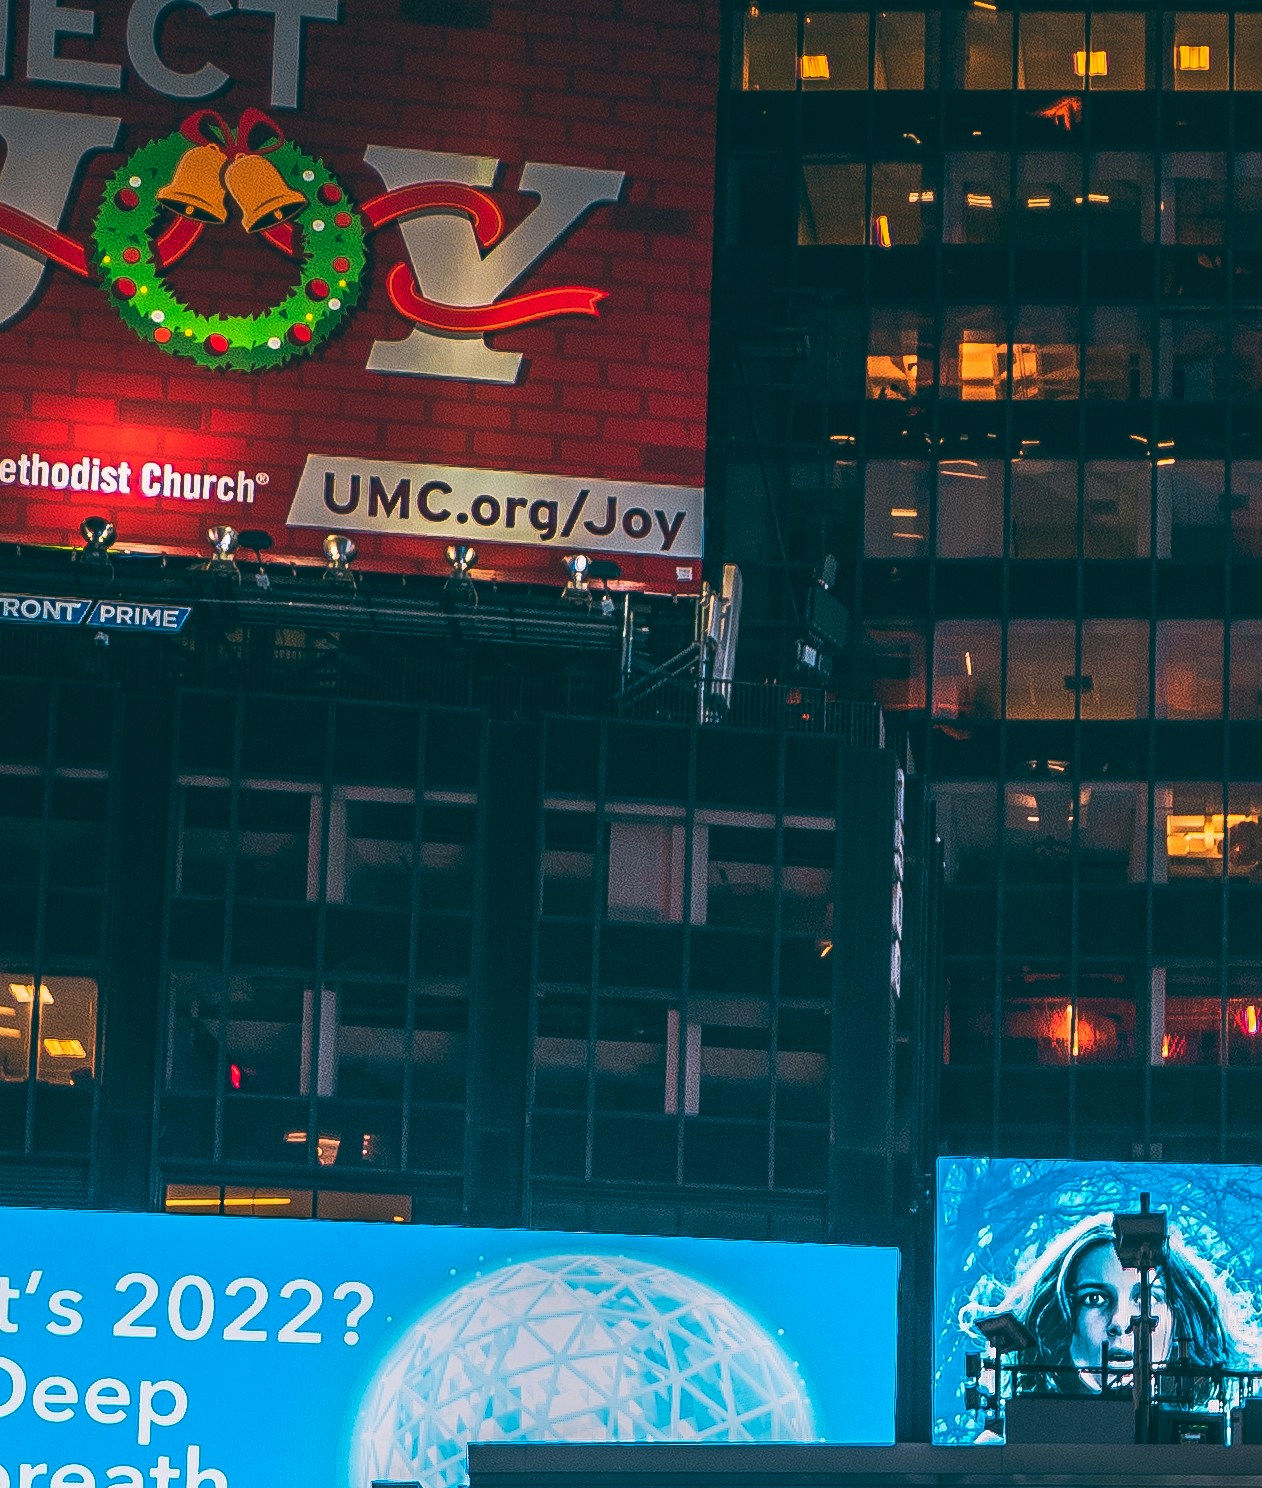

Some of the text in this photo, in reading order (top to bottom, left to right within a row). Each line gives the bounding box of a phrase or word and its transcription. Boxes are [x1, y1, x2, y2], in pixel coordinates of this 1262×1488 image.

[0, 0, 340, 108] ECT
[323, 471, 686, 550] UMC.org/Joy
[113, 1272, 375, 1346] 2022?
